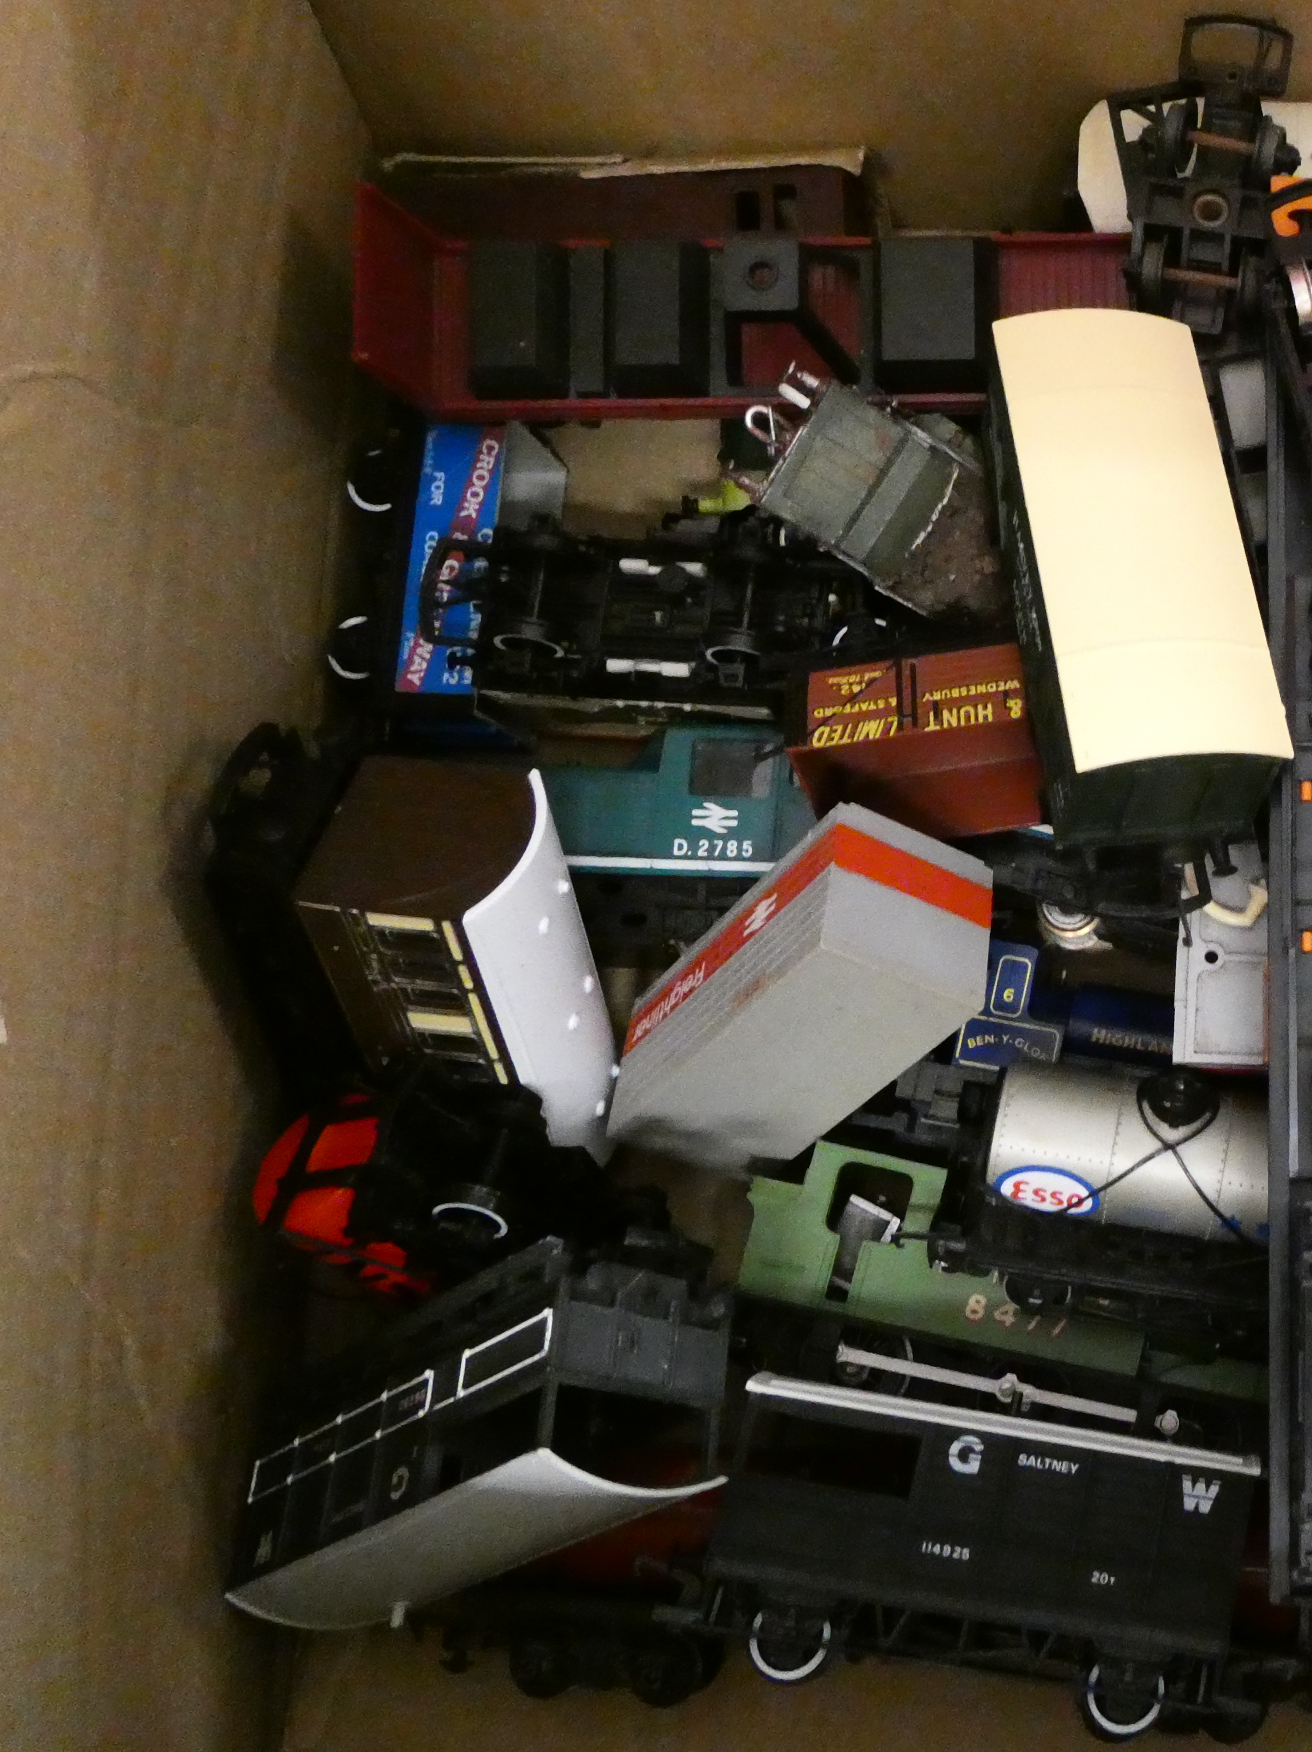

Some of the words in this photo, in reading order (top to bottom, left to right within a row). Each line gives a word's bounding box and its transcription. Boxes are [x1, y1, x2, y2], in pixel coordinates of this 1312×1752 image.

[431, 472, 445, 505] FOR
[460, 439, 499, 518] CROOK
[811, 715, 899, 748] LIMITED
[924, 703, 993, 732] HUNT
[1003, 988, 1015, 1003] 6
[1017, 1453, 1080, 1476] SALTNEY
